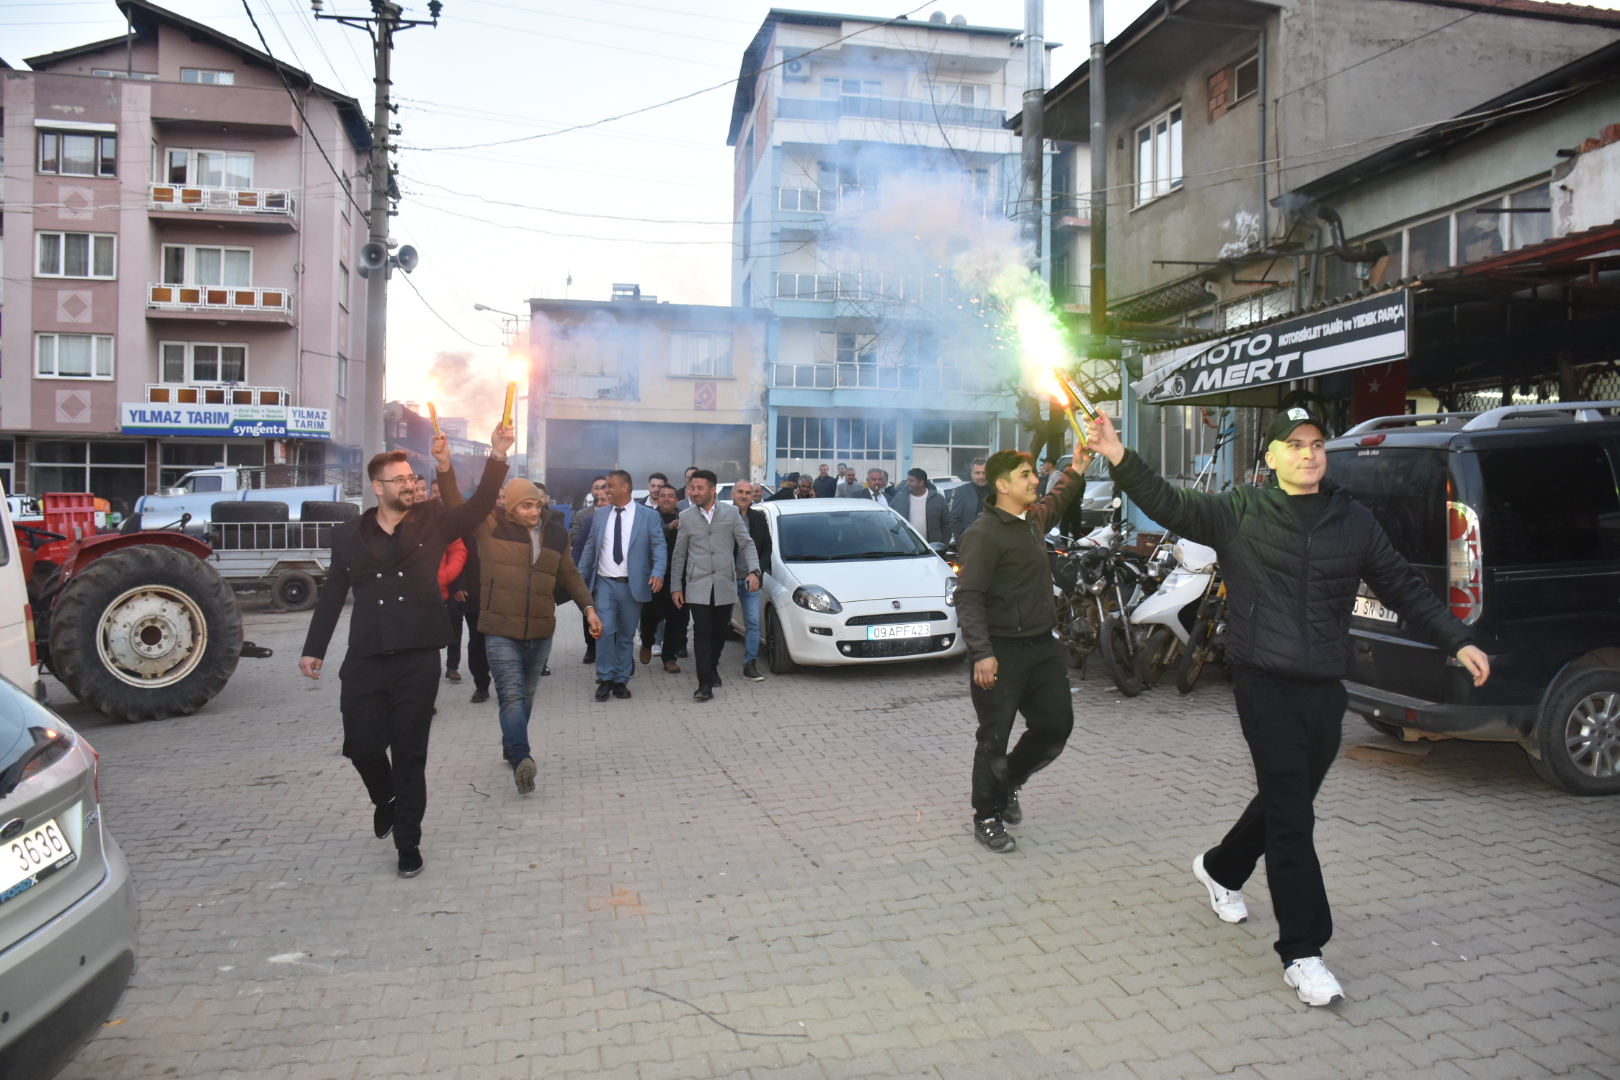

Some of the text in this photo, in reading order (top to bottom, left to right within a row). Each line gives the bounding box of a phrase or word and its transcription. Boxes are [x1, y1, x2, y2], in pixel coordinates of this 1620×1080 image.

[1278, 304, 1405, 347] MOTORSİKLET TAMİR ve YEDEK PARÇA
[1191, 351, 1300, 393] MERT
[128, 409, 230, 425] YILMAZ TARIM
[291, 409, 328, 420] YILMAZ
[233, 425, 285, 437] syngenta
[294, 420, 325, 430] TARIM
[11, 824, 63, 871] 3636
